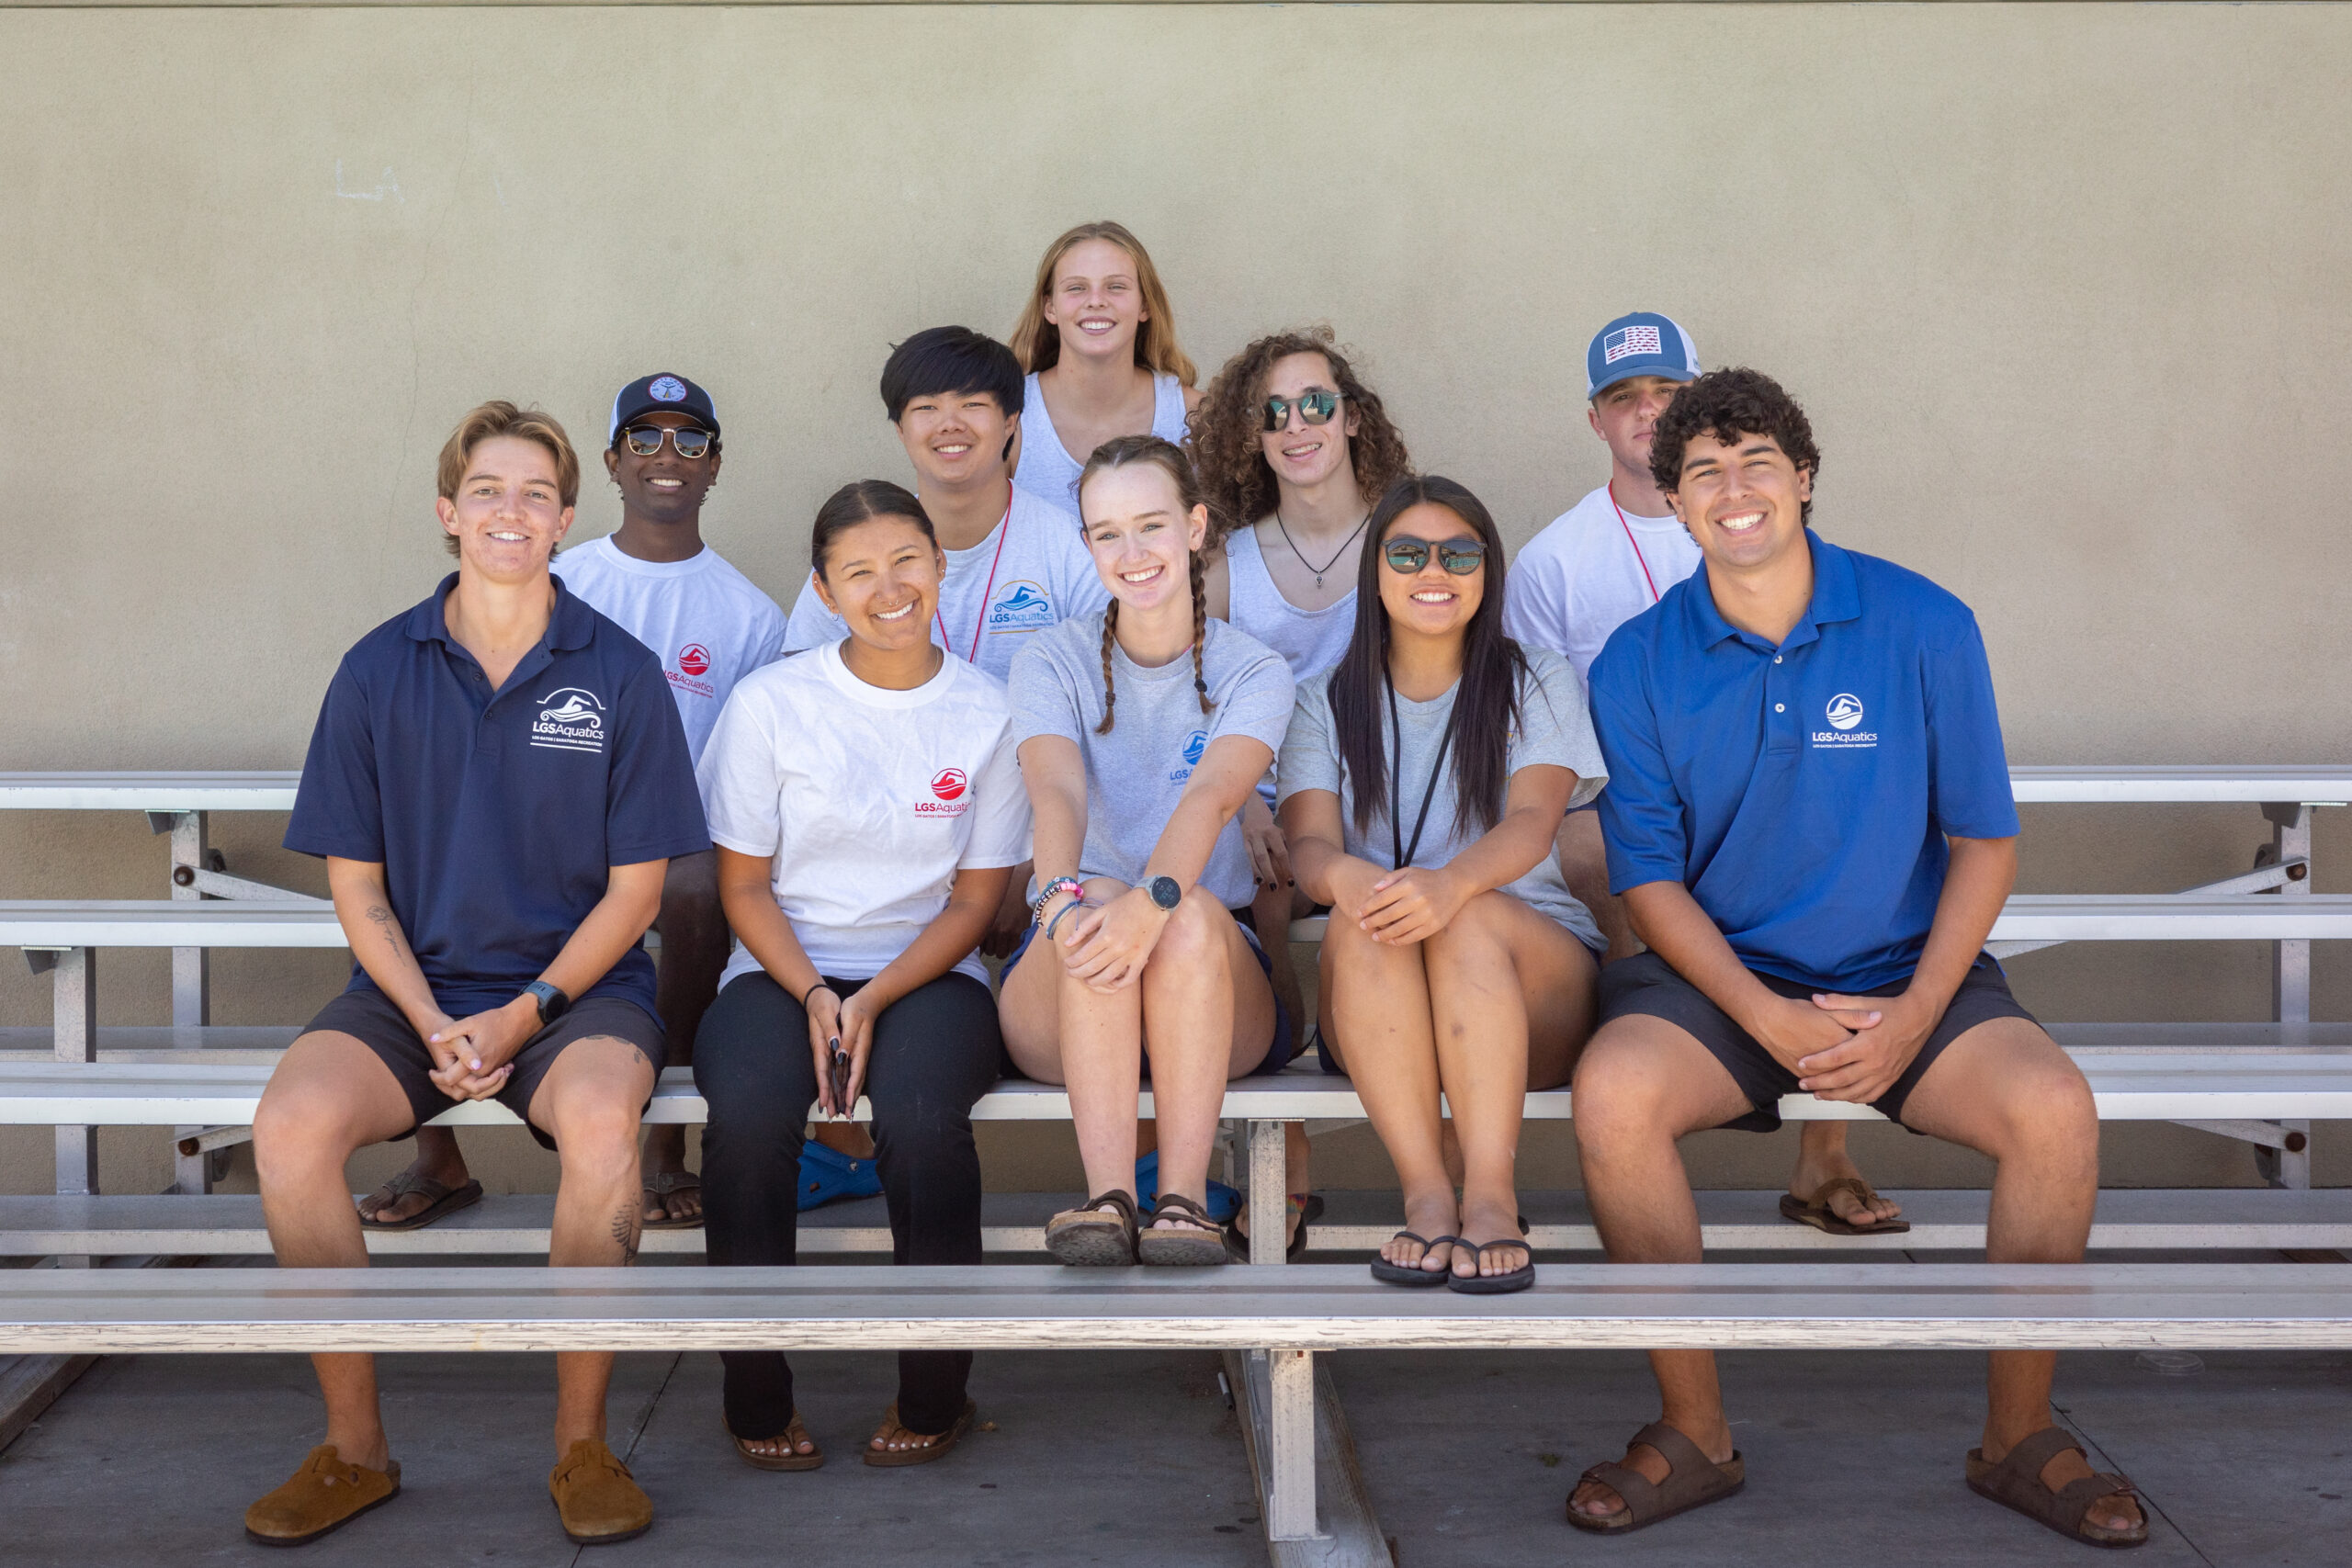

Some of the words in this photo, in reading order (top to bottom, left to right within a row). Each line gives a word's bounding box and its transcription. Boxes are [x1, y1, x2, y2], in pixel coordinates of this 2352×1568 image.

[989, 612, 1054, 624] LGSAquatics
[532, 720, 605, 740] LGSAquatics
[1812, 731, 1878, 743] LGSAquatics
